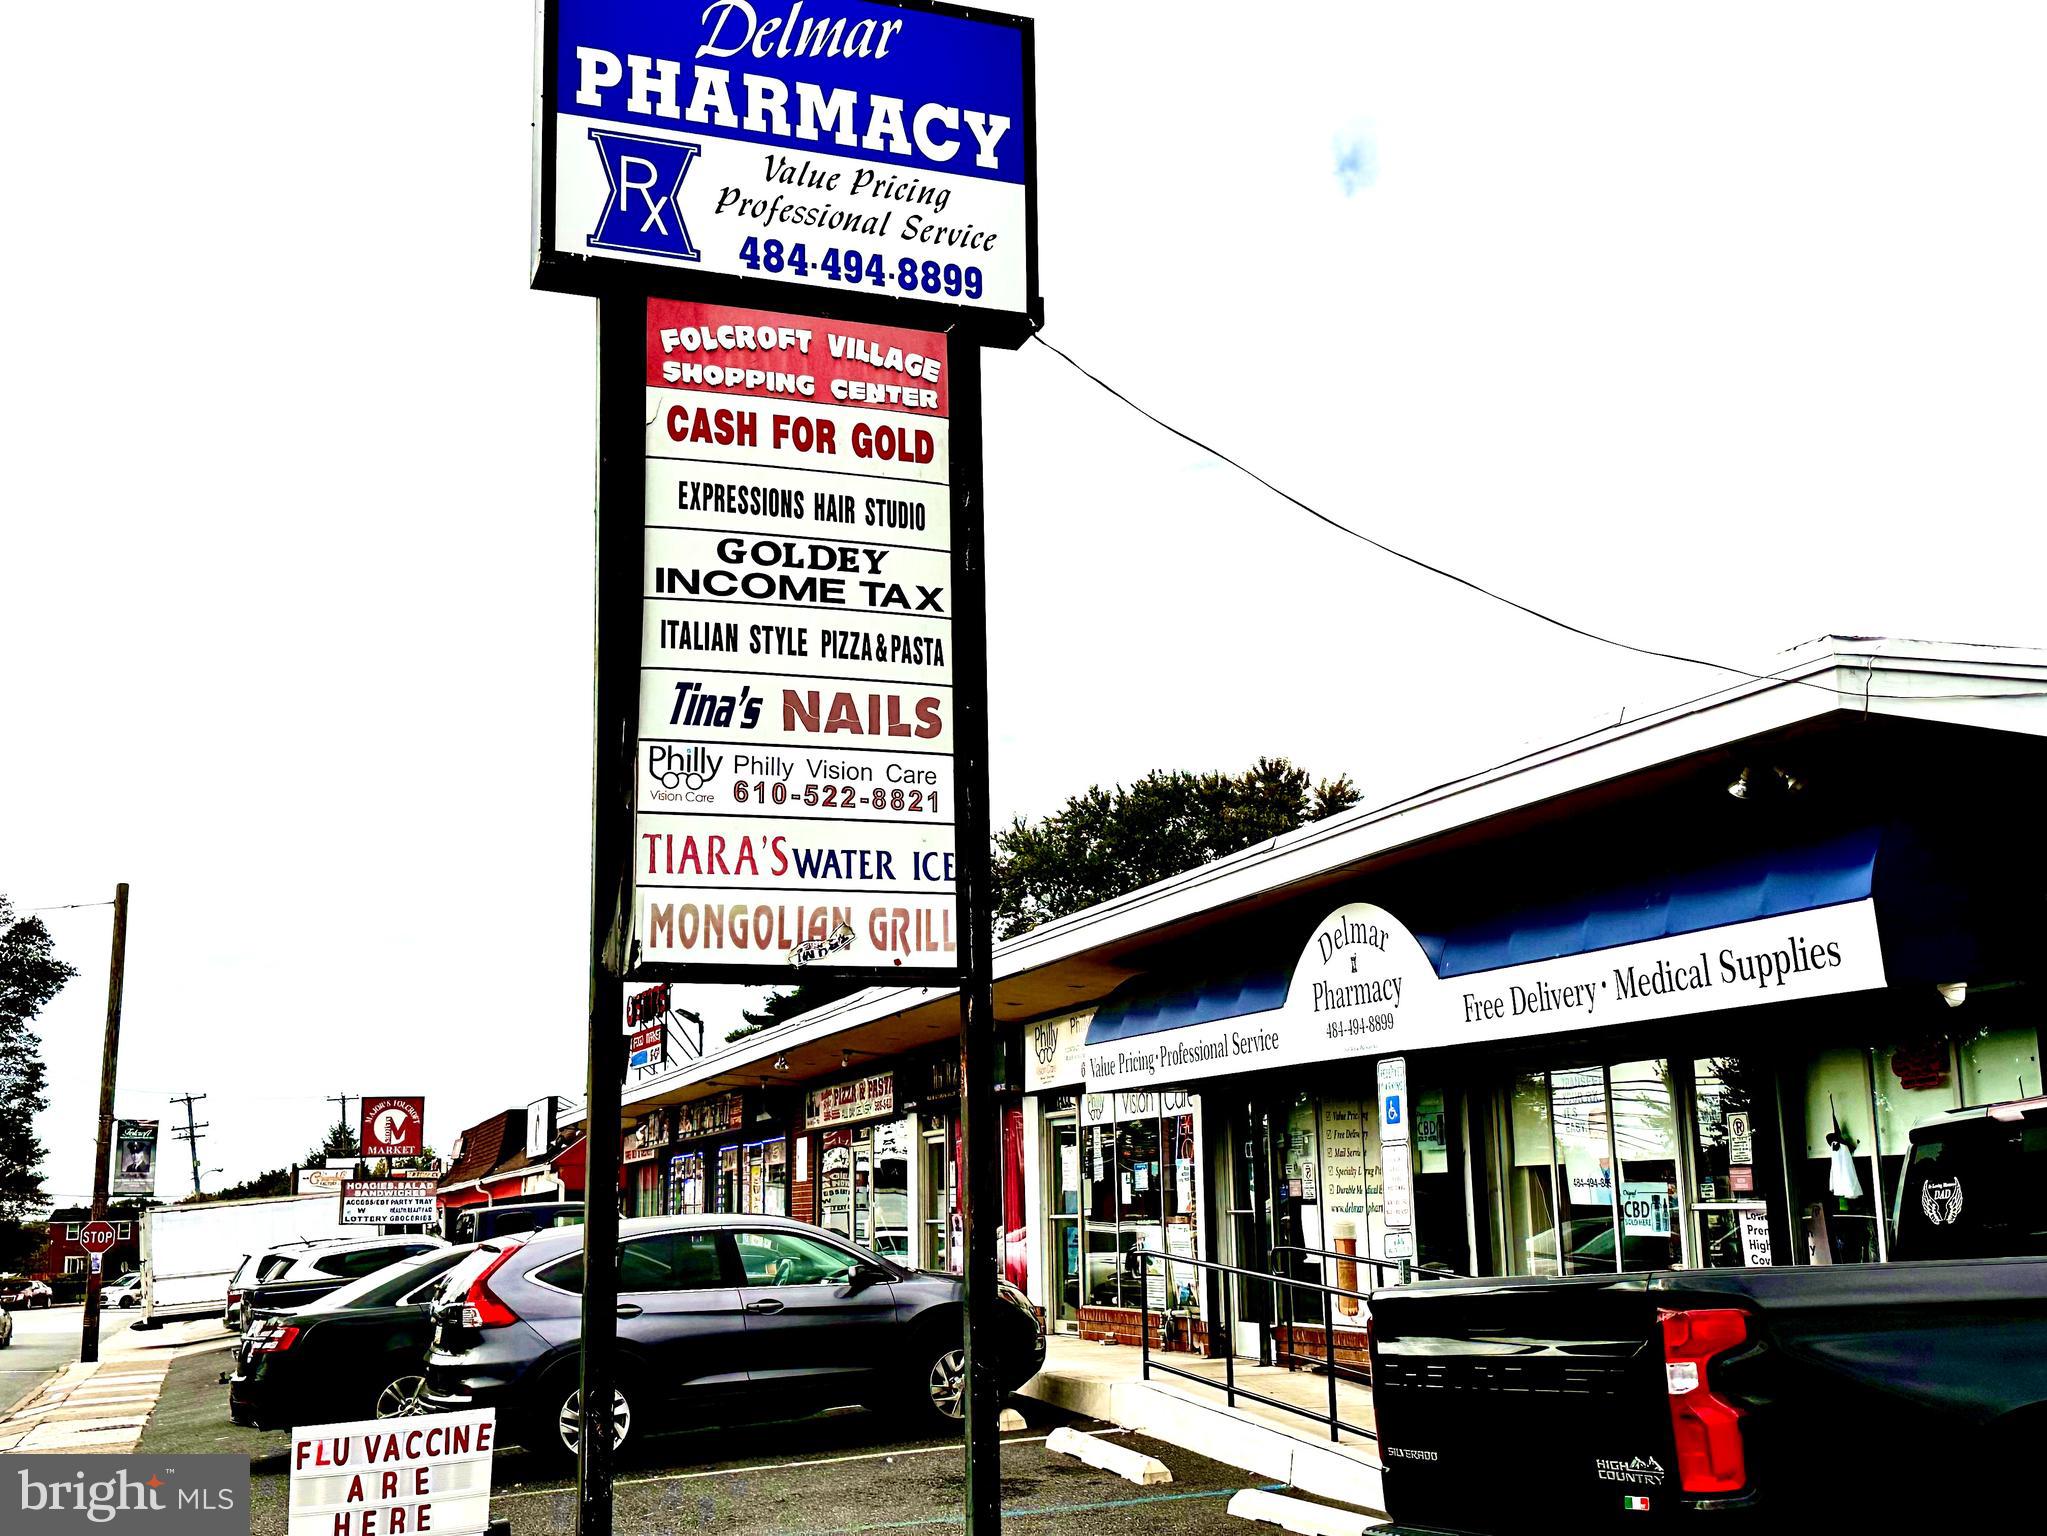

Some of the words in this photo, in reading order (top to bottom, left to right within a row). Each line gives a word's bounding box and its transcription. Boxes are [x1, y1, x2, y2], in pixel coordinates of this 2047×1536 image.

[695, 0, 903, 60] Delmar
[575, 45, 1011, 170] PHARMACY
[765, 154, 838, 192] Value
[850, 168, 951, 212] Pricing
[715, 187, 892, 238] Professional
[901, 214, 998, 252] Service
[659, 325, 812, 354] FOLCROFT
[827, 333, 941, 383] VILLAGE
[661, 361, 815, 396] SHOPPING
[830, 378, 939, 410] CENTER
[667, 405, 757, 447] CASH
[773, 414, 836, 454] FOR
[852, 423, 934, 465] GOLD
[678, 480, 804, 519] EXPRESSIONS
[814, 492, 855, 524] HAIR
[865, 498, 926, 531] STUDIO
[716, 538, 889, 575] GOLDEY
[655, 567, 846, 605] INCOME
[859, 580, 945, 613] TAX
[661, 619, 738, 652] ITALIAN
[749, 624, 808, 657] STYLE
[669, 681, 763, 729] Tina's
[782, 689, 942, 739] NAILS
[649, 745, 724, 780] Philly
[734, 754, 794, 781] Philly
[806, 758, 873, 781] Vision
[886, 763, 937, 785] Care
[650, 789, 682, 803] Vision
[685, 791, 715, 803] Care
[733, 780, 939, 813] 610-522-8821
[642, 833, 788, 877] TIARA'S
[792, 848, 896, 880] WATER
[913, 851, 956, 882] ICE
[650, 903, 851, 951] MONGOLIAN
[869, 907, 956, 957] GRILL
[1317, 915, 1389, 965] Delmar
[1312, 977, 1402, 1012] Pharmacy
[1462, 993, 1505, 1023] Free
[1509, 979, 1597, 1017] Delivery
[1613, 953, 1712, 1001] Medical
[1718, 936, 1841, 988] Supplies
[1034, 1021, 1059, 1050] Philly
[1326, 1012, 1394, 1039] 484-494-8899
[1090, 1058, 1116, 1078] Value
[1118, 1050, 1155, 1075] Pricing
[1160, 1033, 1229, 1067] Professional
[1232, 1028, 1279, 1055] Service
[834, 1084, 857, 1107] PIZZA
[1121, 1093, 1154, 1114] Vision
[1417, 1120, 1436, 1136] CBD
[367, 1146, 416, 1155] MARKET
[354, 1189, 427, 1197] SANDWICHES
[1624, 1200, 1650, 1218] CBD
[1934, 1189, 1951, 1200] DAD
[82, 1231, 113, 1244] STOP
[296, 1435, 350, 1471] FLU
[364, 1422, 493, 1464] VACCINE
[1387, 1447, 1438, 1461] SILVERADO
[1596, 1458, 1629, 1471] HIGH
[347, 1466, 430, 1504] ARE
[1598, 1470, 1665, 1486] COUNTRY
[333, 1503, 432, 1536] HERE
